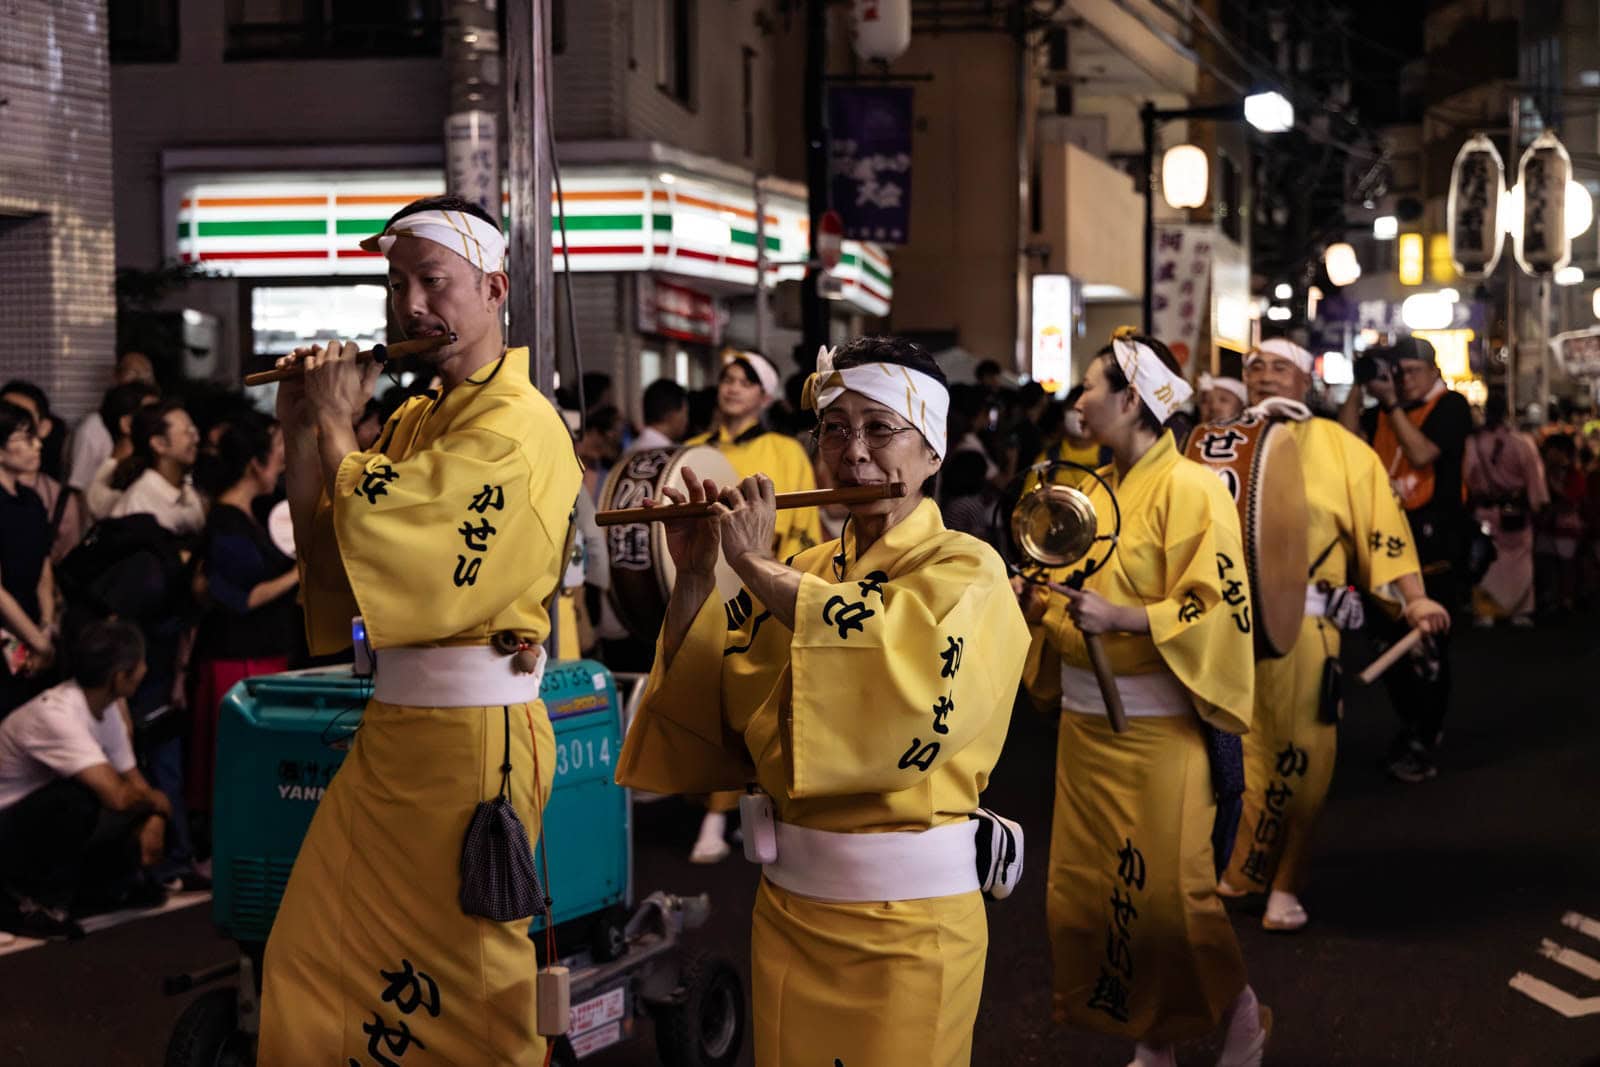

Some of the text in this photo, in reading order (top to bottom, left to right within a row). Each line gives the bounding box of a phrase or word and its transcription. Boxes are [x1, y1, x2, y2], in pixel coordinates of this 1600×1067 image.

[453, 484, 505, 587] かせい
[558, 737, 611, 775] 3014
[349, 959, 441, 1067] かせ
